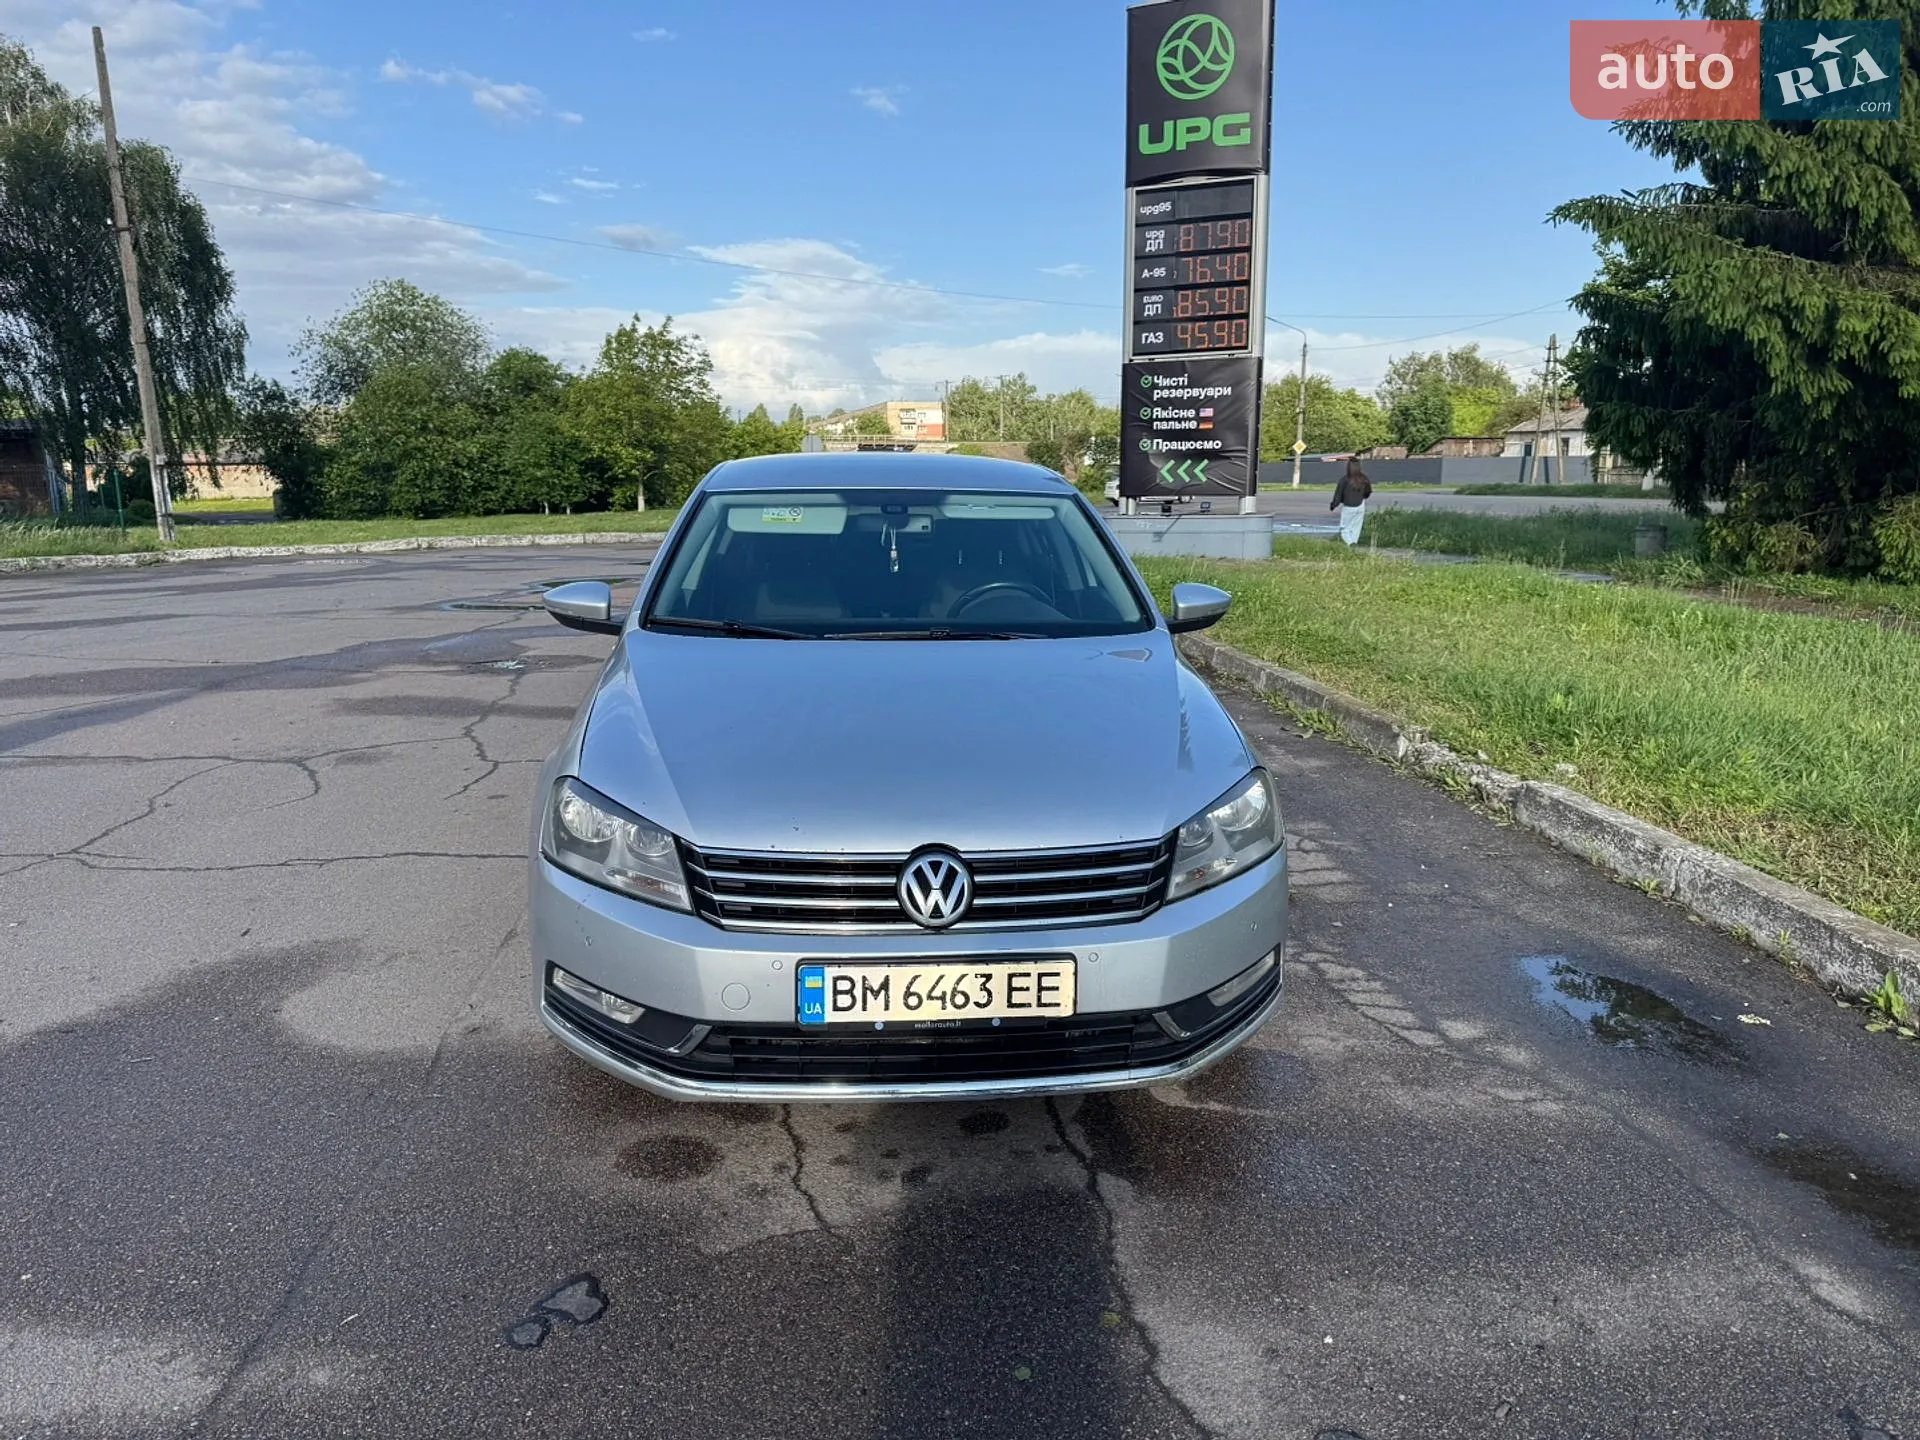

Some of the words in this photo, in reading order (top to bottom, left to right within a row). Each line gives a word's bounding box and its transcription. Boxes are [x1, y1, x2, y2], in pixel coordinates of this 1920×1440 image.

[1139, 112, 1251, 154] UPG
[1140, 201, 1172, 215] upg95
[1145, 229, 1165, 240] upg
[1180, 218, 1250, 251] 87.90
[1145, 239, 1164, 252] ДП
[1181, 252, 1249, 283] 76.40
[1178, 286, 1248, 317] 85.90
[1144, 303, 1161, 316] ДП
[1141, 332, 1164, 344] ГАЗ
[1177, 319, 1247, 348] 45.90
[1154, 374, 1188, 387] Чисті
[1153, 386, 1232, 400] резервуари
[1153, 406, 1196, 419] Якісне
[1153, 419, 1198, 430] пальне
[1152, 439, 1222, 452] Працюємо
[832, 974, 890, 1012] BM
[903, 973, 993, 1010] 6463
[1007, 972, 1061, 1008] EE
[805, 1002, 822, 1014] UA
